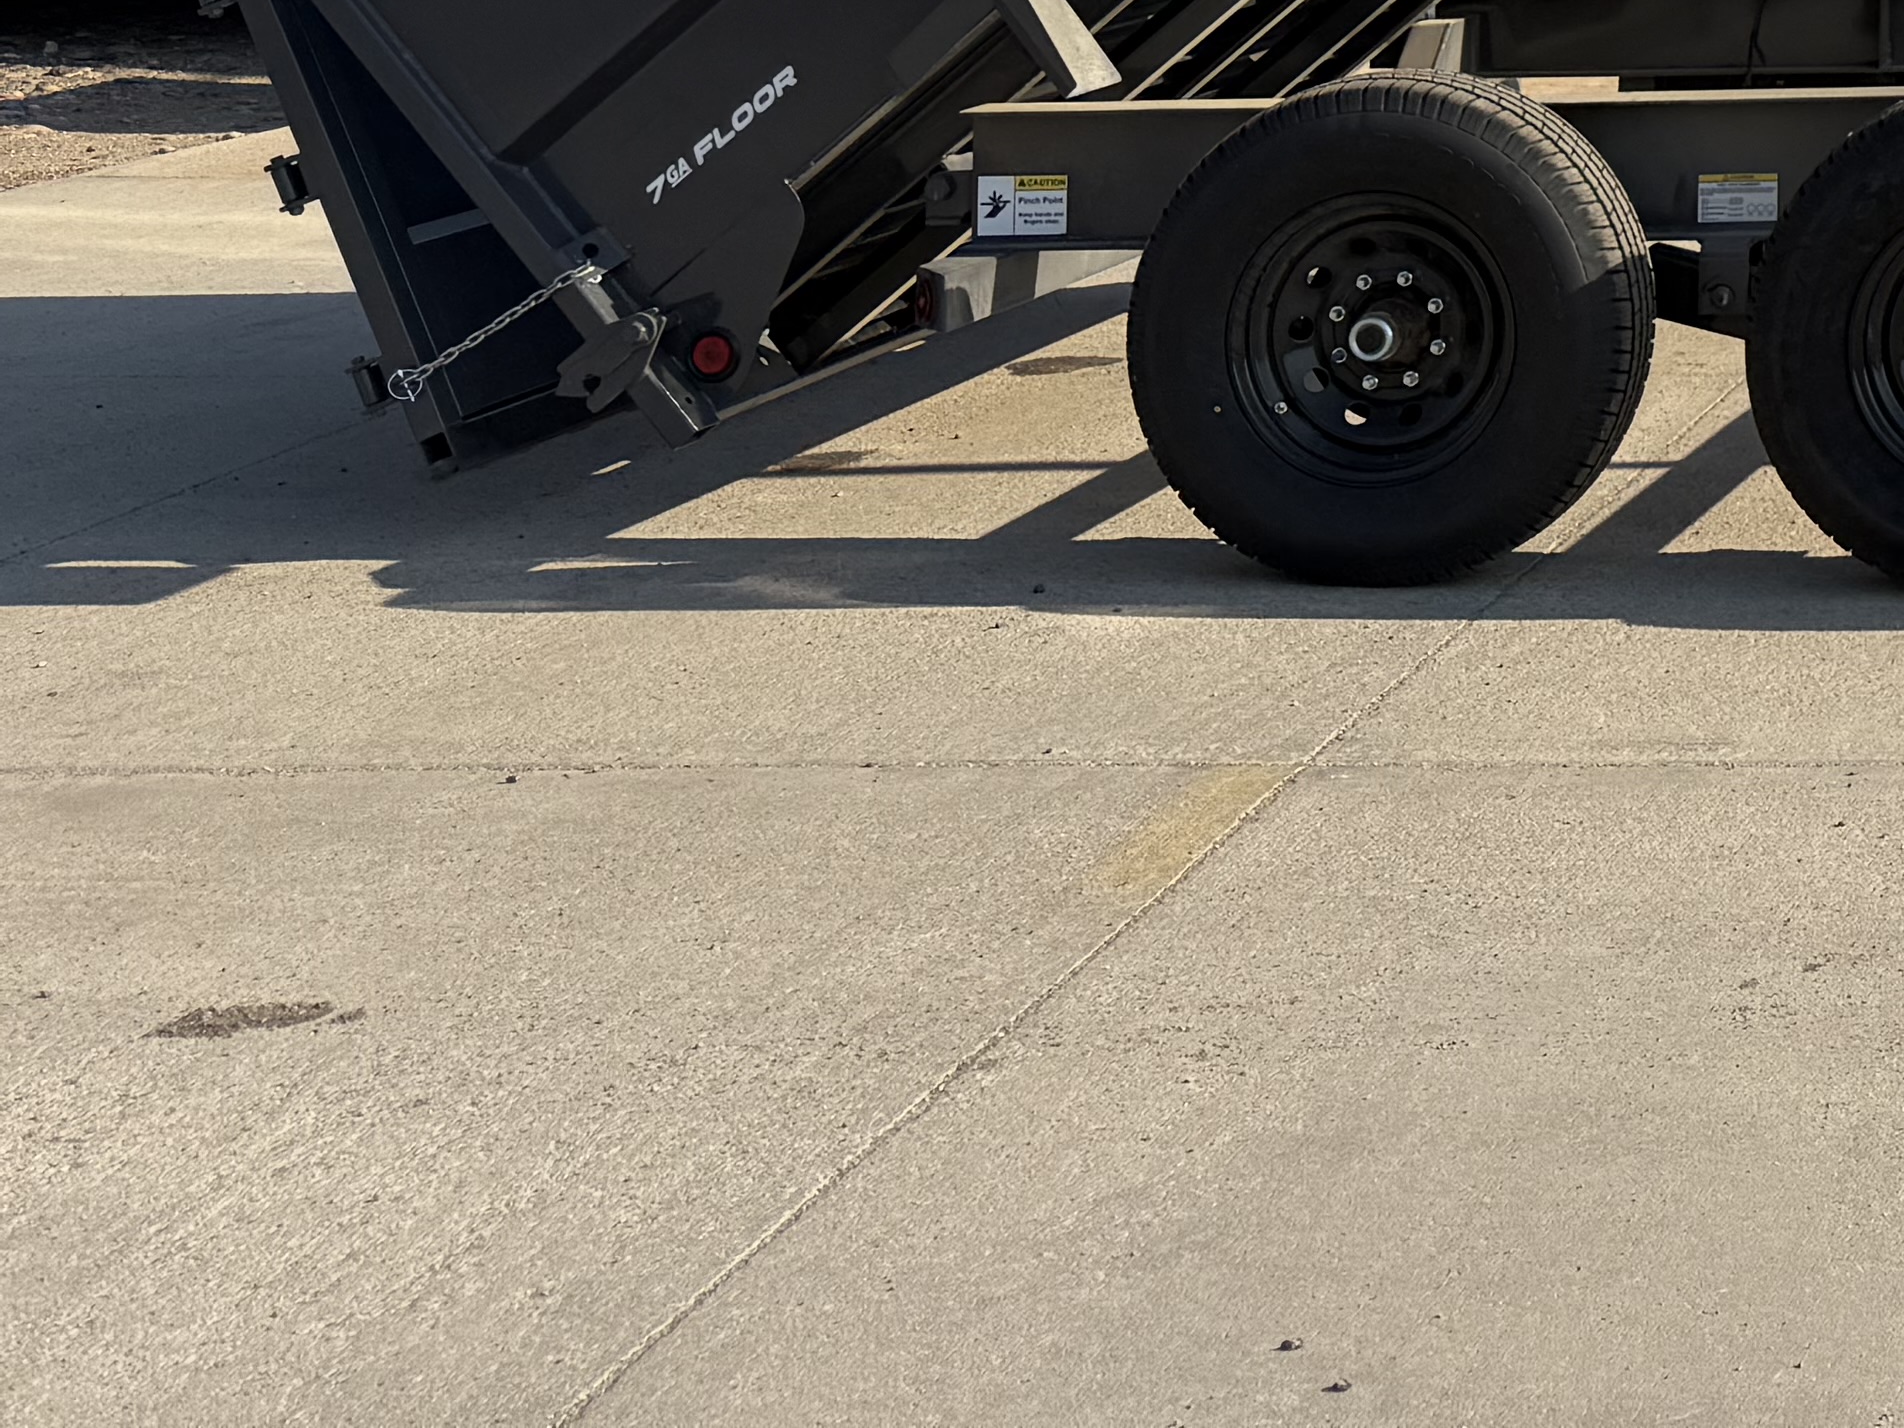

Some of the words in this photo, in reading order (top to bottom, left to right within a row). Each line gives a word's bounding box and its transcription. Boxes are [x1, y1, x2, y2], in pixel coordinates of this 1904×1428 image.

[693, 65, 798, 166] FLOOR
[1026, 178, 1066, 188] CAUTION
[1018, 196, 1041, 205] Pinch
[1042, 196, 1064, 205] Point
